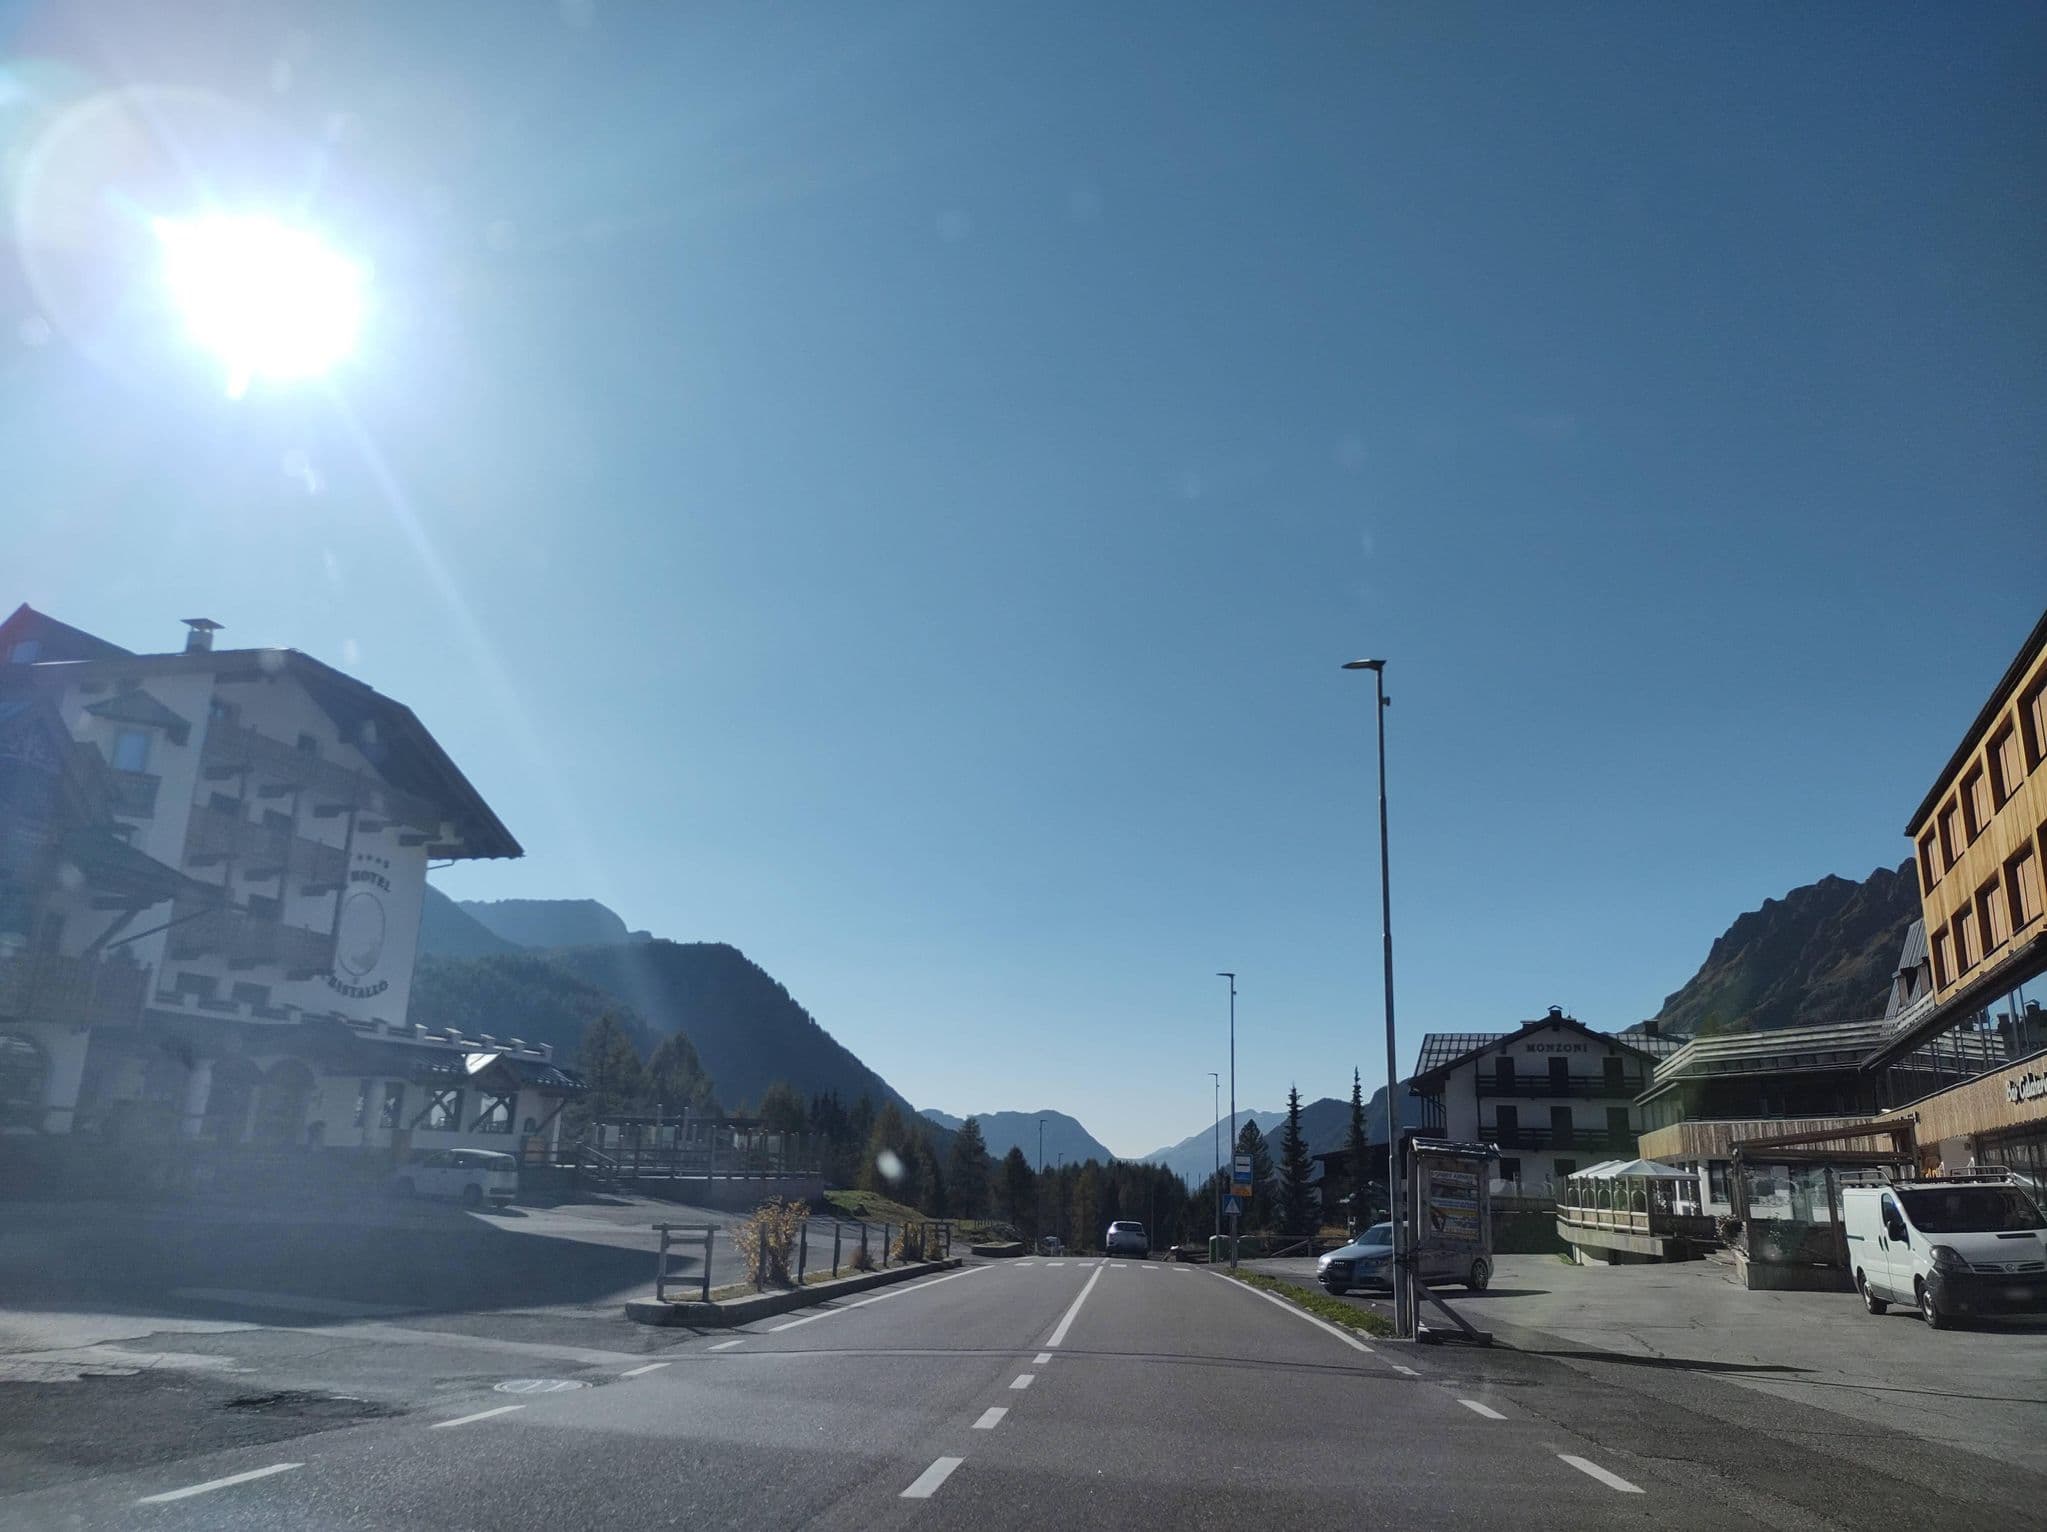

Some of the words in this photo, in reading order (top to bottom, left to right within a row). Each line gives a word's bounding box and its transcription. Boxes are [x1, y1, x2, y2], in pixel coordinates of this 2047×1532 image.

[351, 870, 392, 892] HOTEL
[325, 975, 389, 998] RISTALLO
[1526, 1043, 1588, 1053] MONZONI
